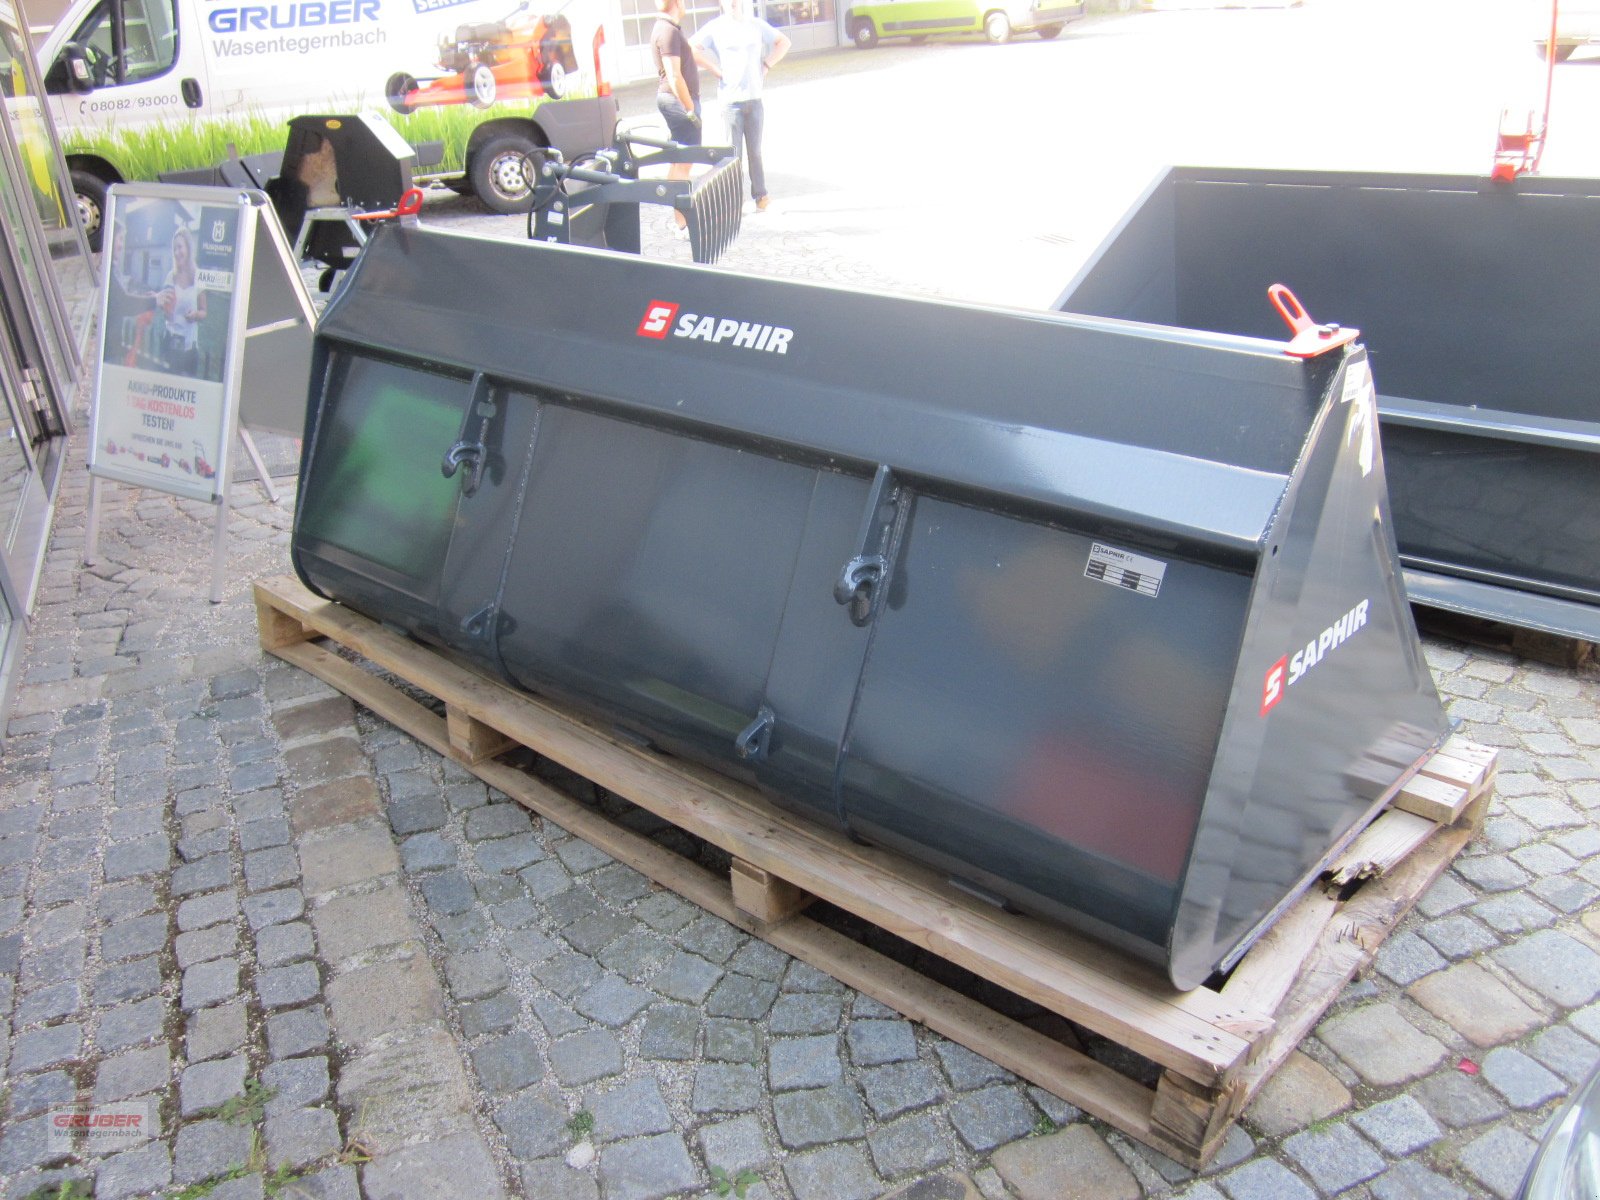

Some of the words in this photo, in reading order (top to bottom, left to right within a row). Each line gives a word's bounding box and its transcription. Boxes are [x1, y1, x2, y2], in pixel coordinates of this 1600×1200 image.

[208, 0, 381, 34] GRUBER
[212, 28, 387, 58] Wasentegernbach
[673, 313, 794, 355] SAPHIR
[142, 414, 174, 431] TESTEN!
[147, 399, 196, 419] KOSTENLOS
[1100, 547, 1125, 560] SAPHIR
[1288, 598, 1369, 685] SAPHIR
